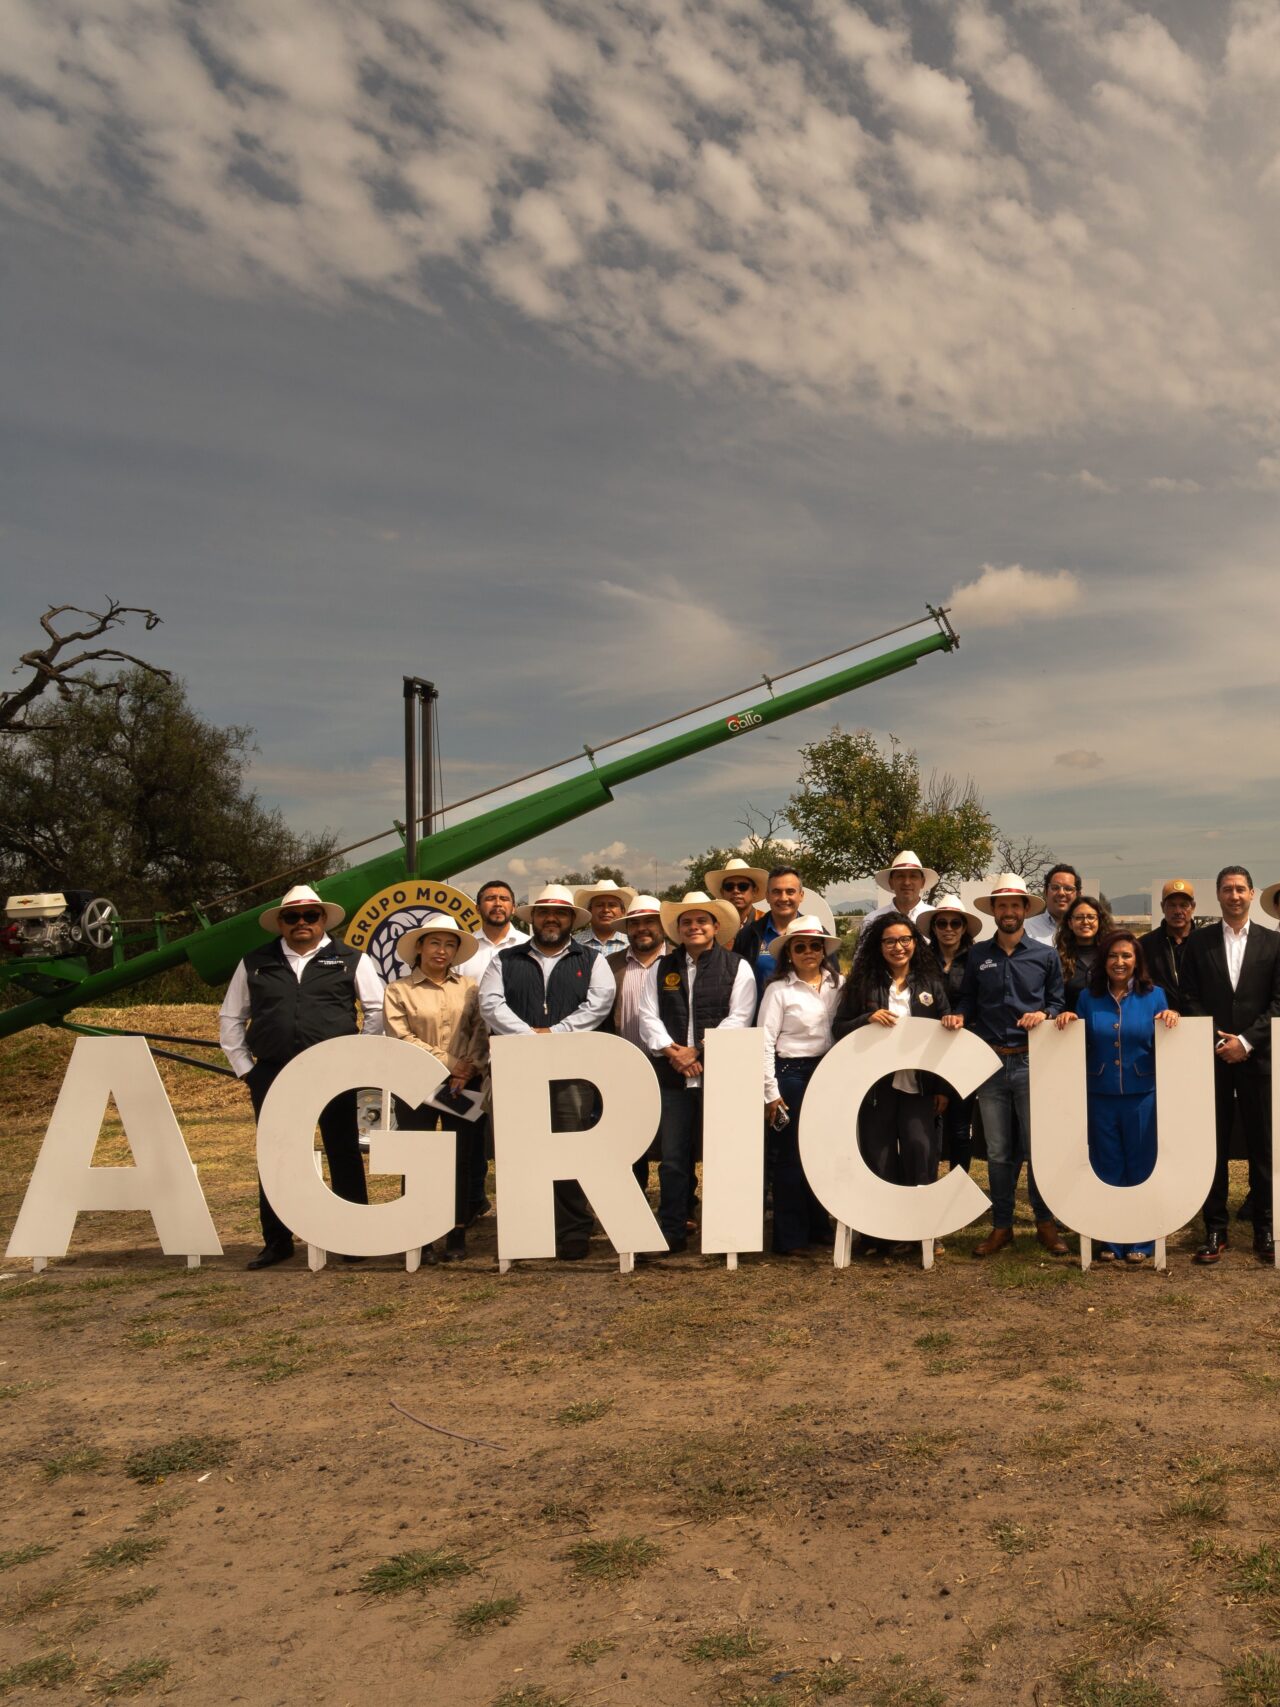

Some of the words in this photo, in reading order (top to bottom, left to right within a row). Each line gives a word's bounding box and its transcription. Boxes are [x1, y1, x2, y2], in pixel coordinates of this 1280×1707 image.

[727, 714, 763, 732] Gallo
[350, 890, 407, 947] GRUPO
[416, 887, 481, 933] MODEL
